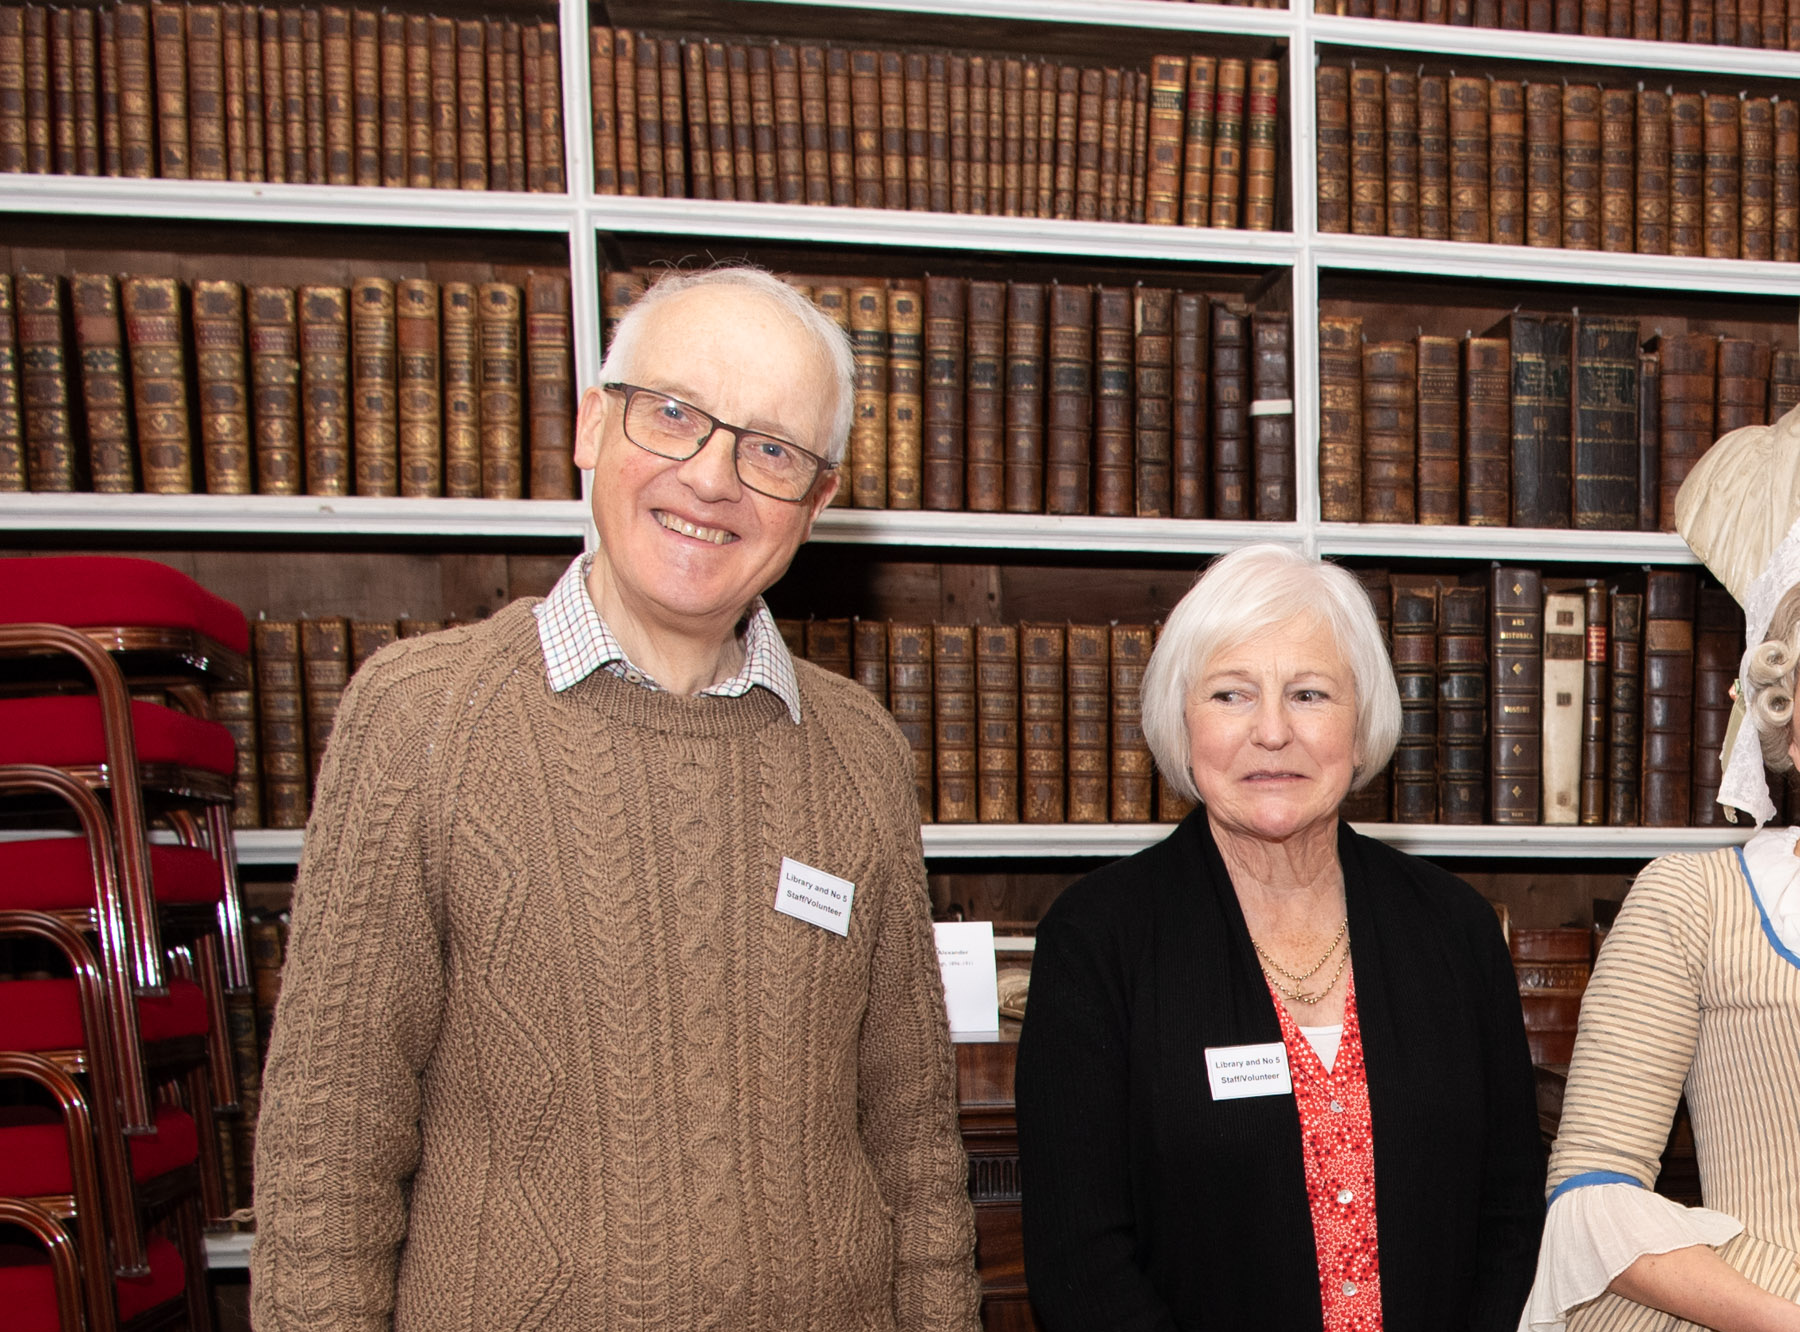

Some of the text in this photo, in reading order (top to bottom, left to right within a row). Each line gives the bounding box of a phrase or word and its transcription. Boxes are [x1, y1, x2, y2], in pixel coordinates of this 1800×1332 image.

[1511, 618, 1525, 626] ARS
[1500, 631, 1534, 640] HISTORICA
[786, 872, 813, 889] Library
[814, 885, 829, 895] and
[830, 890, 841, 900] No
[786, 889, 842, 917] Staff/Volunteer
[1215, 1056, 1281, 1069] Library and No 5
[1221, 1073, 1280, 1084] Staff/Volunteer
